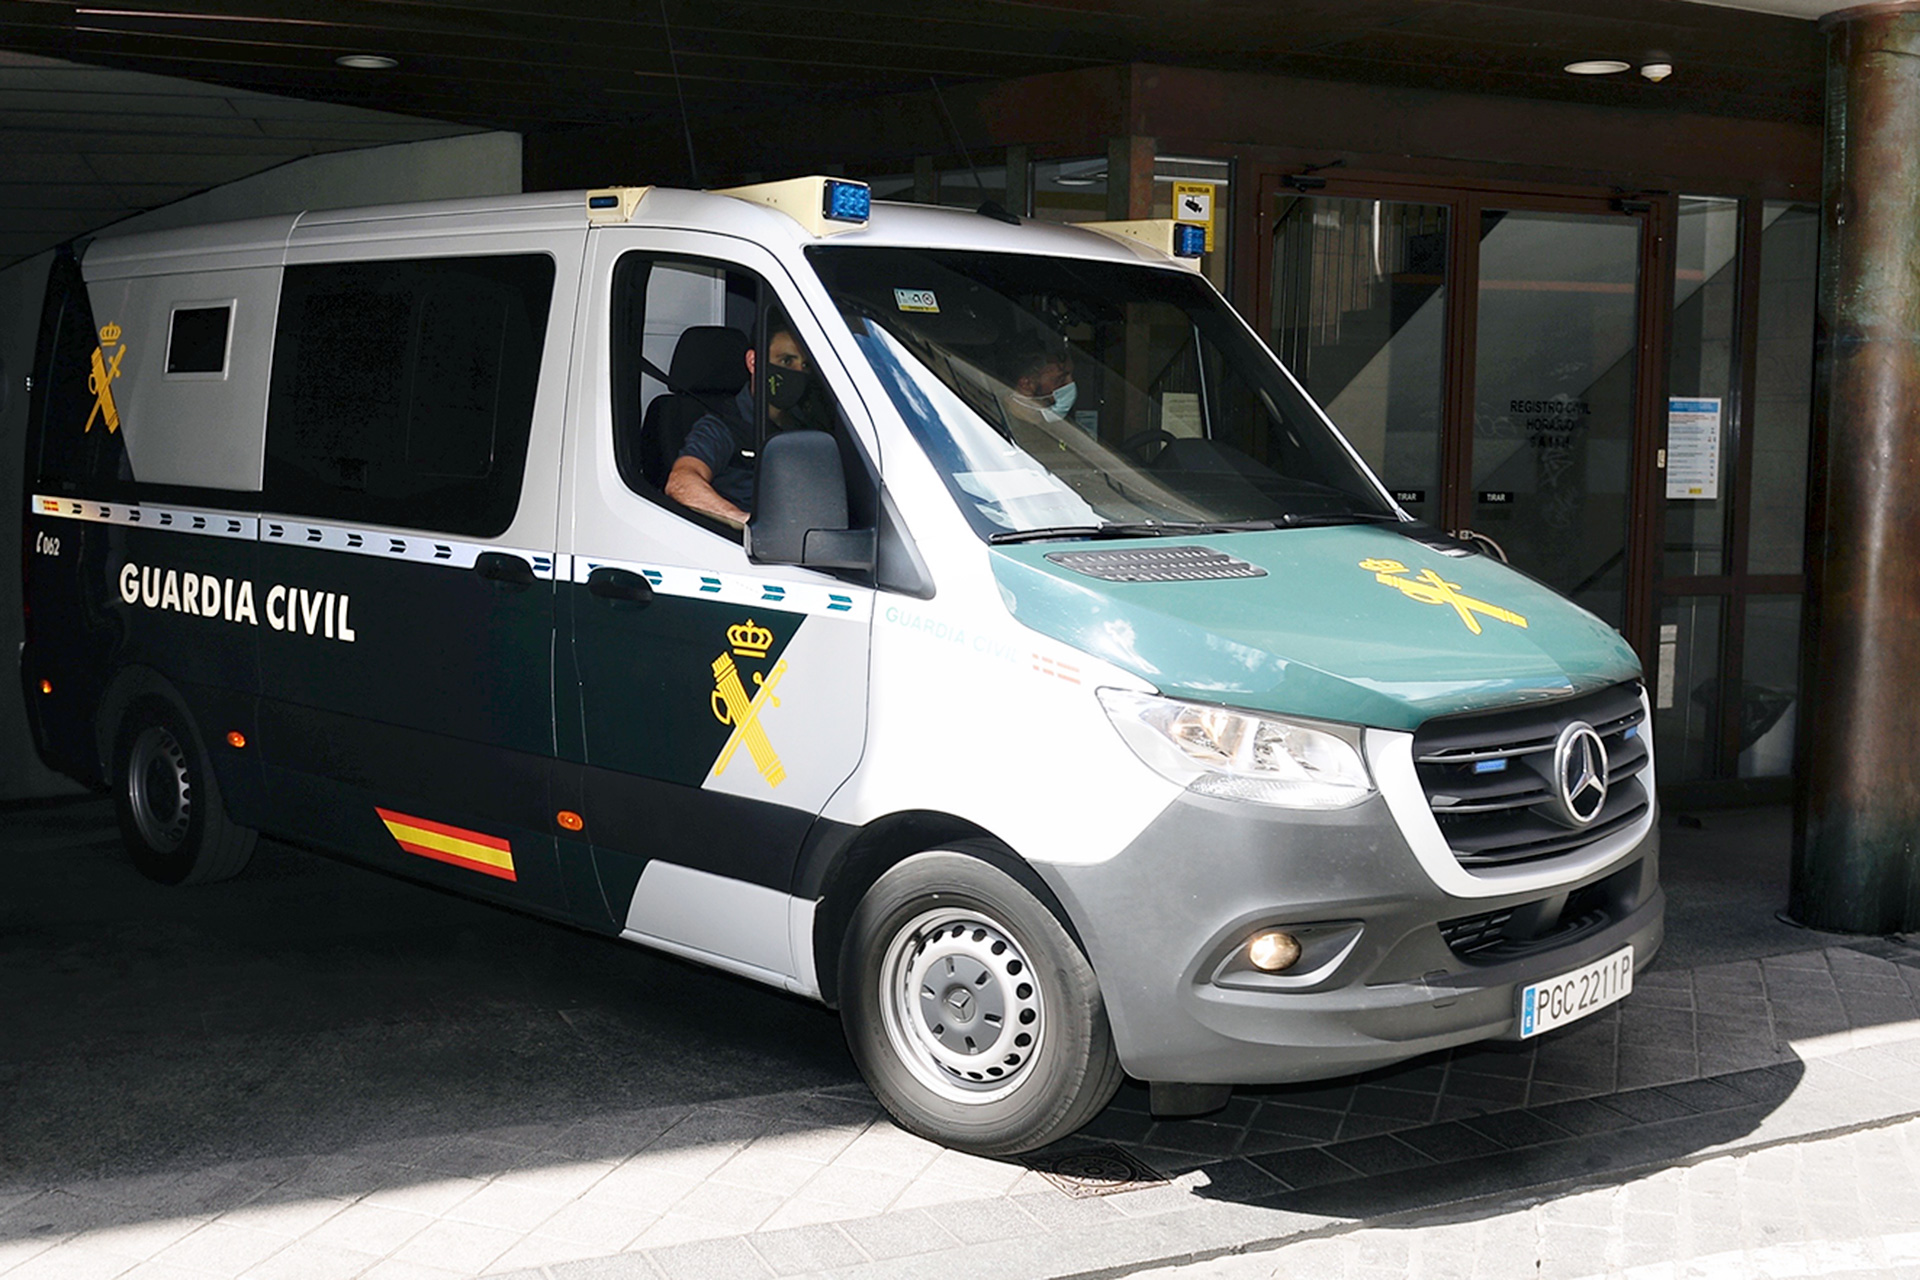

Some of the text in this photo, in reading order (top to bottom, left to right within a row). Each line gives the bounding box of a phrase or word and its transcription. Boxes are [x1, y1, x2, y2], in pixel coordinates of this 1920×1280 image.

[1510, 400, 1563, 413] REGISTRO
[1526, 418, 1574, 432] HORARIO
[1397, 492, 1417, 501] TIRAR
[1486, 493, 1506, 502] TIRAR
[43, 536, 60, 556] 062
[119, 562, 355, 642] GUARDIA CIVIL
[885, 606, 1018, 663] GUARDIA CIVIL
[1537, 980, 1575, 1026] PGC
